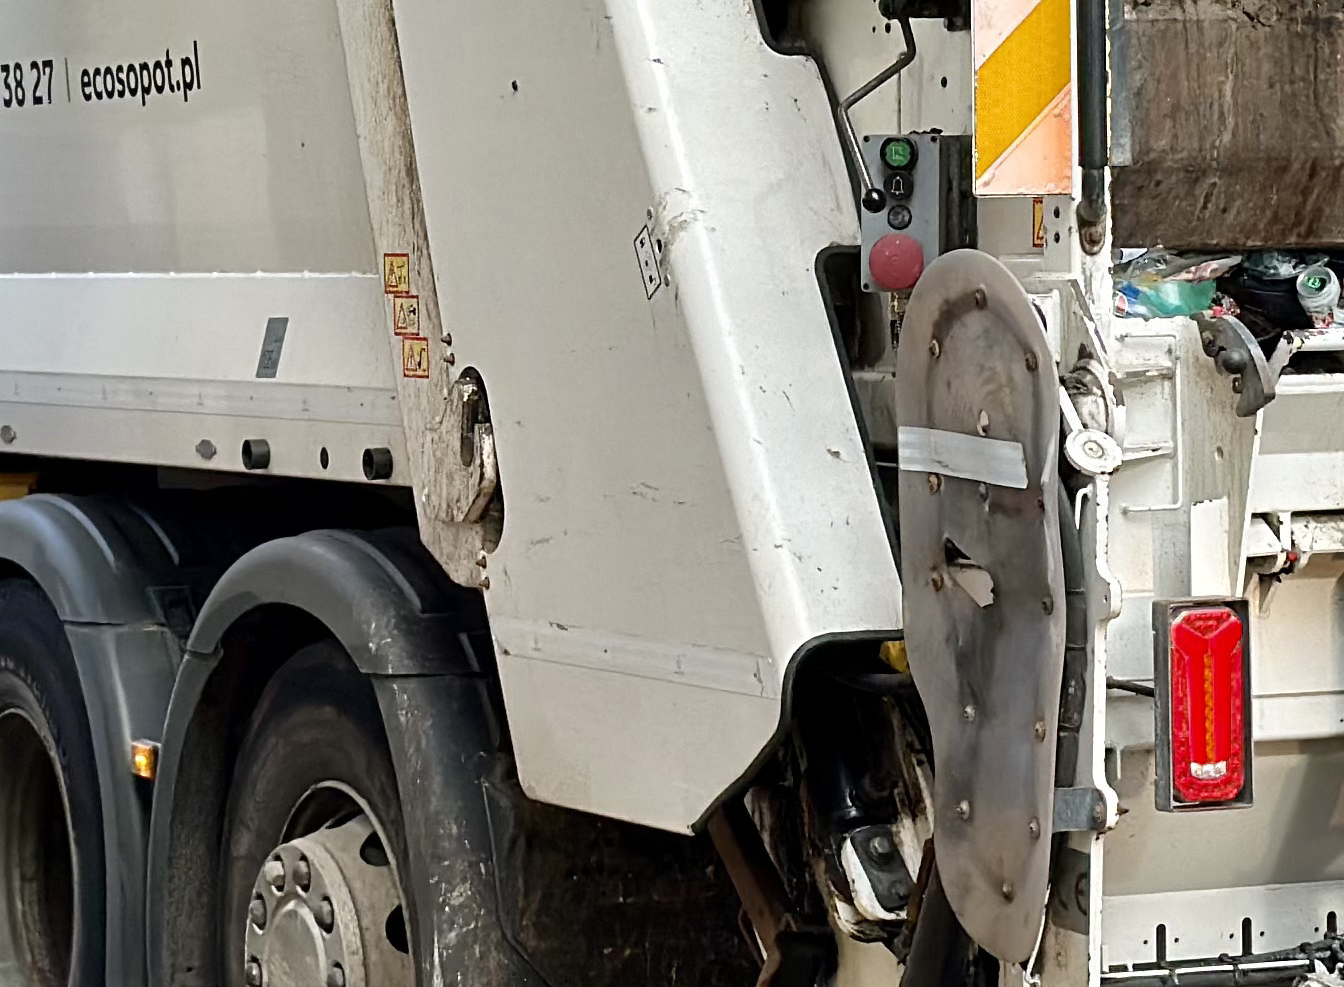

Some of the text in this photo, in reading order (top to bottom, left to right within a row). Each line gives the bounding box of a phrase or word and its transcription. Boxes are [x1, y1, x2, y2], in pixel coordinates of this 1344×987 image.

[0, 61, 26, 109] 38
[30, 59, 54, 106] 27
[80, 41, 202, 107] ecosopot.pl
